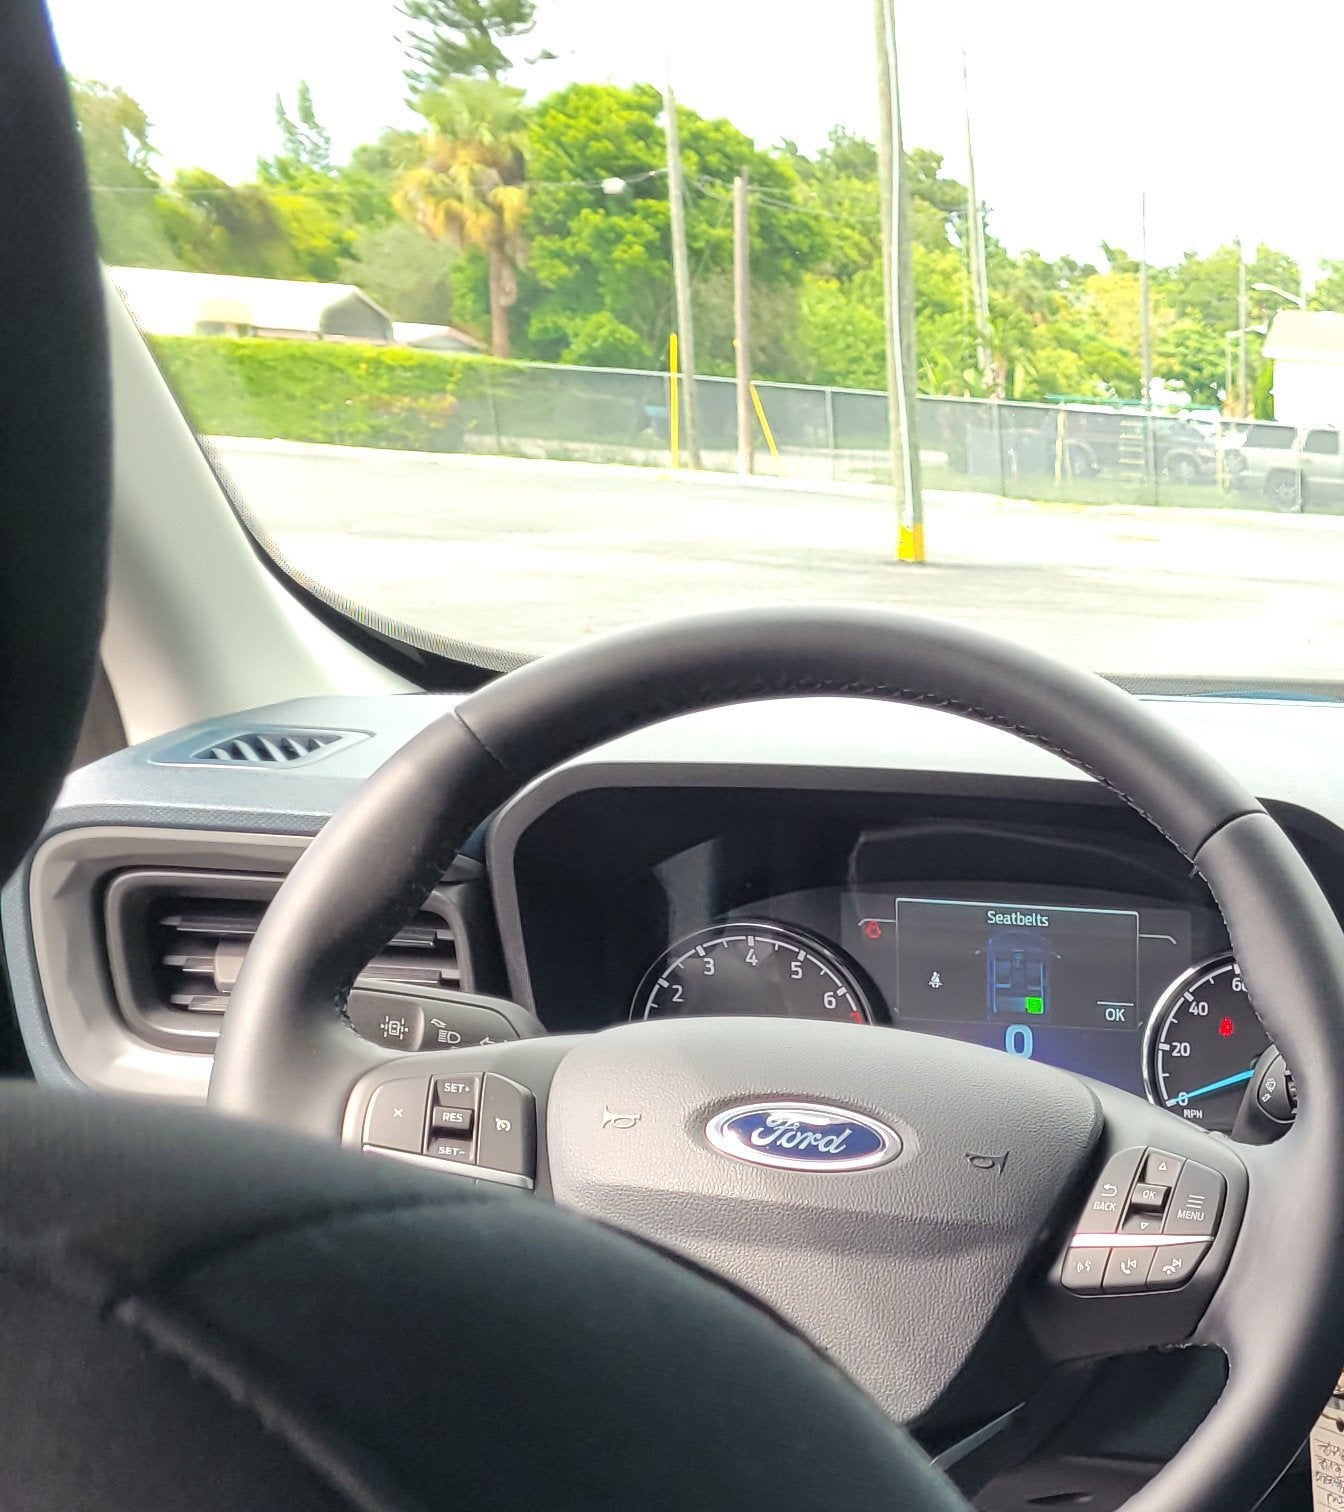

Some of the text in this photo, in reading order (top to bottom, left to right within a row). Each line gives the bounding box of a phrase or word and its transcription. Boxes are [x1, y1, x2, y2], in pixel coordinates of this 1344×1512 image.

[987, 910, 1049, 927] Seatbelts
[745, 949, 758, 966] 4
[703, 957, 715, 976] 3
[791, 961, 803, 979] 5
[671, 984, 684, 1002] 2
[823, 991, 836, 1009] 6
[1105, 1007, 1126, 1022] OK
[1189, 1001, 1208, 1016] 40
[1005, 1023, 1034, 1060] 0
[1171, 1042, 1191, 1057] 20
[442, 1112, 463, 1123] RES
[1183, 1109, 1203, 1119] MPH
[750, 1112, 853, 1154] Ford
[1143, 1190, 1156, 1199] OK
[1093, 1202, 1117, 1211] BACK
[1177, 1210, 1205, 1221] MENU
